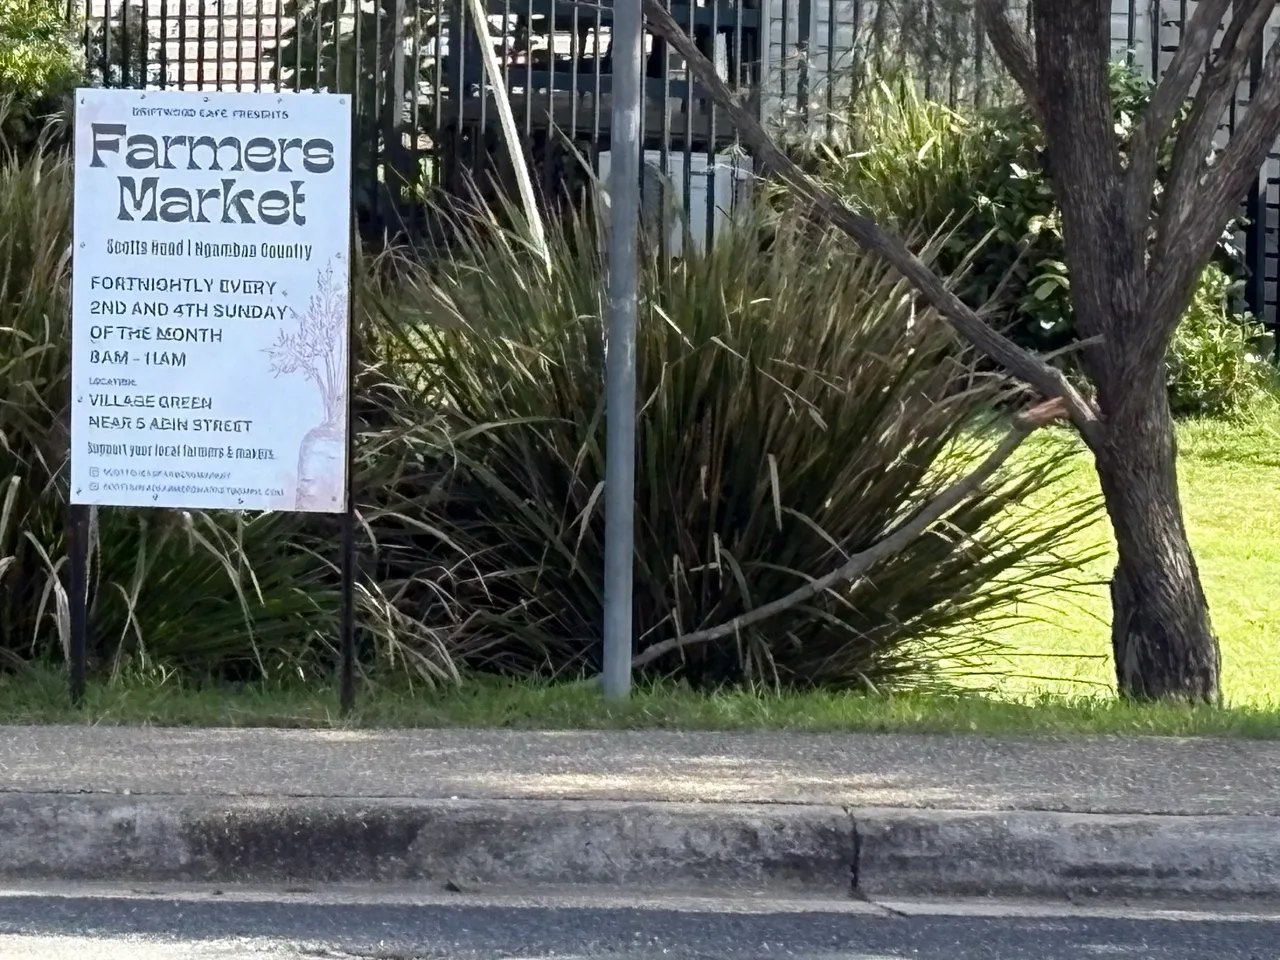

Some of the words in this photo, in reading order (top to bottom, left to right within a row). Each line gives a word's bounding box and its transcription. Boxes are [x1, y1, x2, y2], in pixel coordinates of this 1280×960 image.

[89, 122, 335, 174] Farmers
[117, 176, 306, 227] Market
[91, 276, 213, 293] FORTNIGHTLY
[219, 279, 277, 295] EVERY
[90, 300, 127, 315] 2ND
[131, 301, 169, 317] AND
[173, 302, 208, 318] 4TH
[213, 303, 288, 320] SUNDAY
[90, 325, 113, 339] OF
[116, 326, 152, 340] THE
[156, 327, 223, 342] MONTH
[90, 350, 129, 365] 8AM
[145, 351, 186, 367] 11AM
[88, 394, 155, 408] VILLAGE
[158, 395, 212, 409] GREEN
[88, 416, 132, 429] NEAR
[193, 418, 252, 433] STREET
